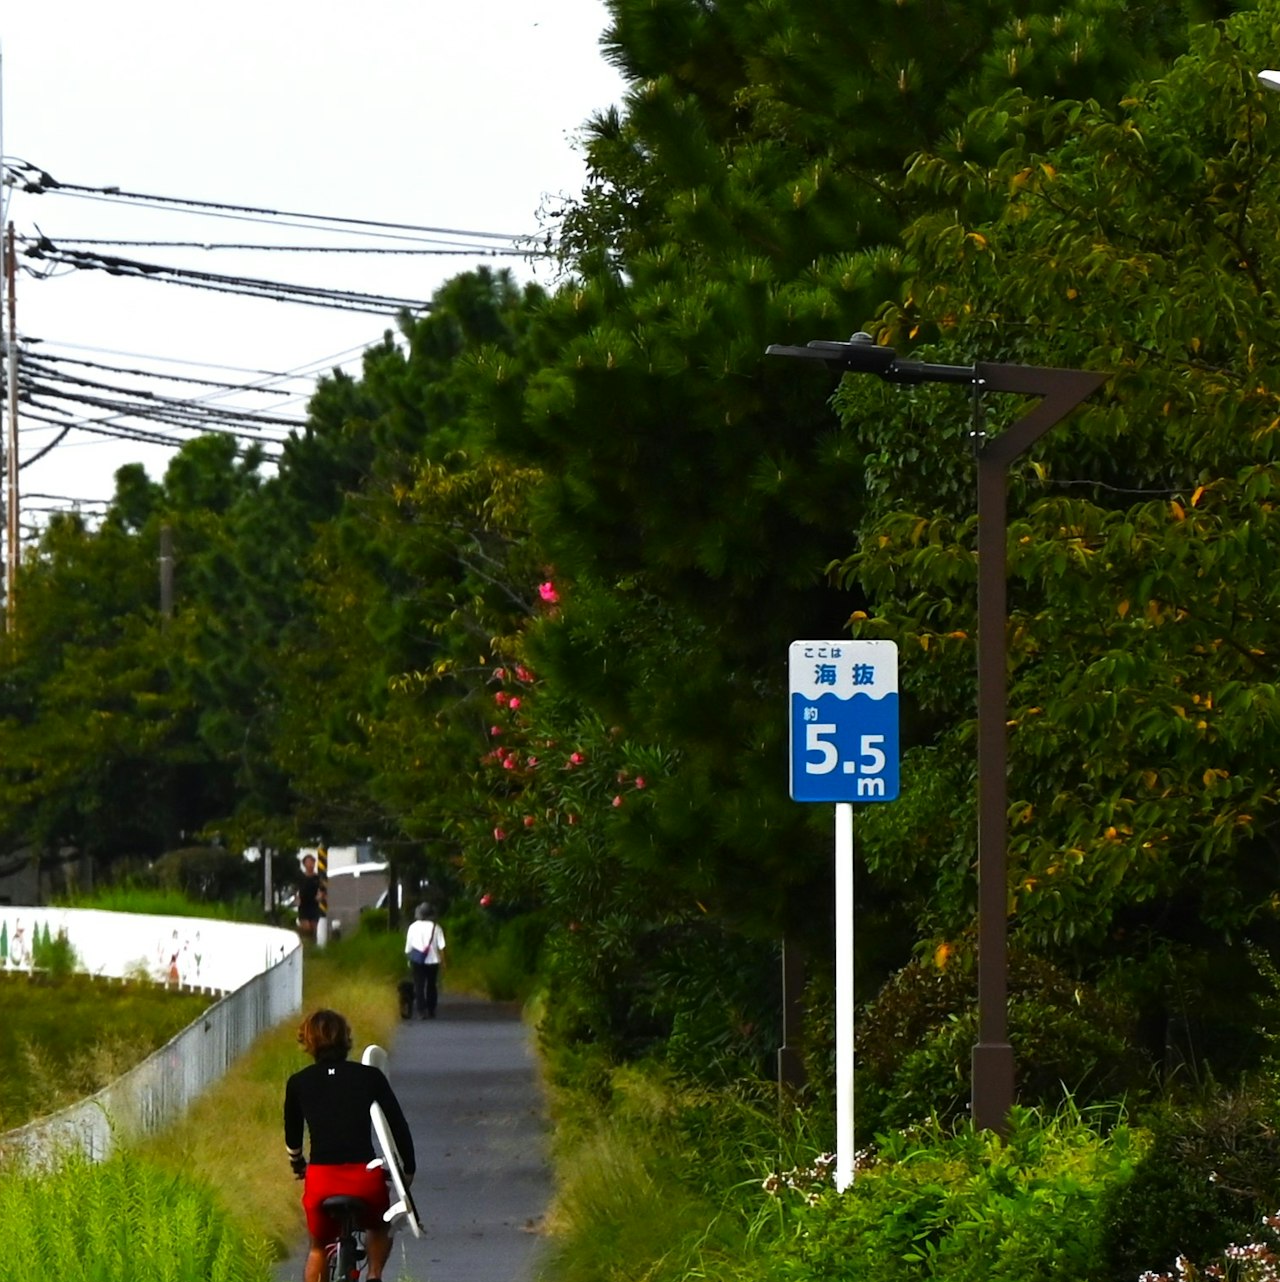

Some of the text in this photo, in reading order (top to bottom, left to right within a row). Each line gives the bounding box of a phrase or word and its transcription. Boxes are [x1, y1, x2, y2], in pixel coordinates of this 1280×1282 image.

[804, 648, 842, 658] ここは
[814, 663, 874, 686] 海抜
[803, 706, 818, 721] 約
[805, 723, 886, 775] 5.5
[857, 777, 885, 796] m
